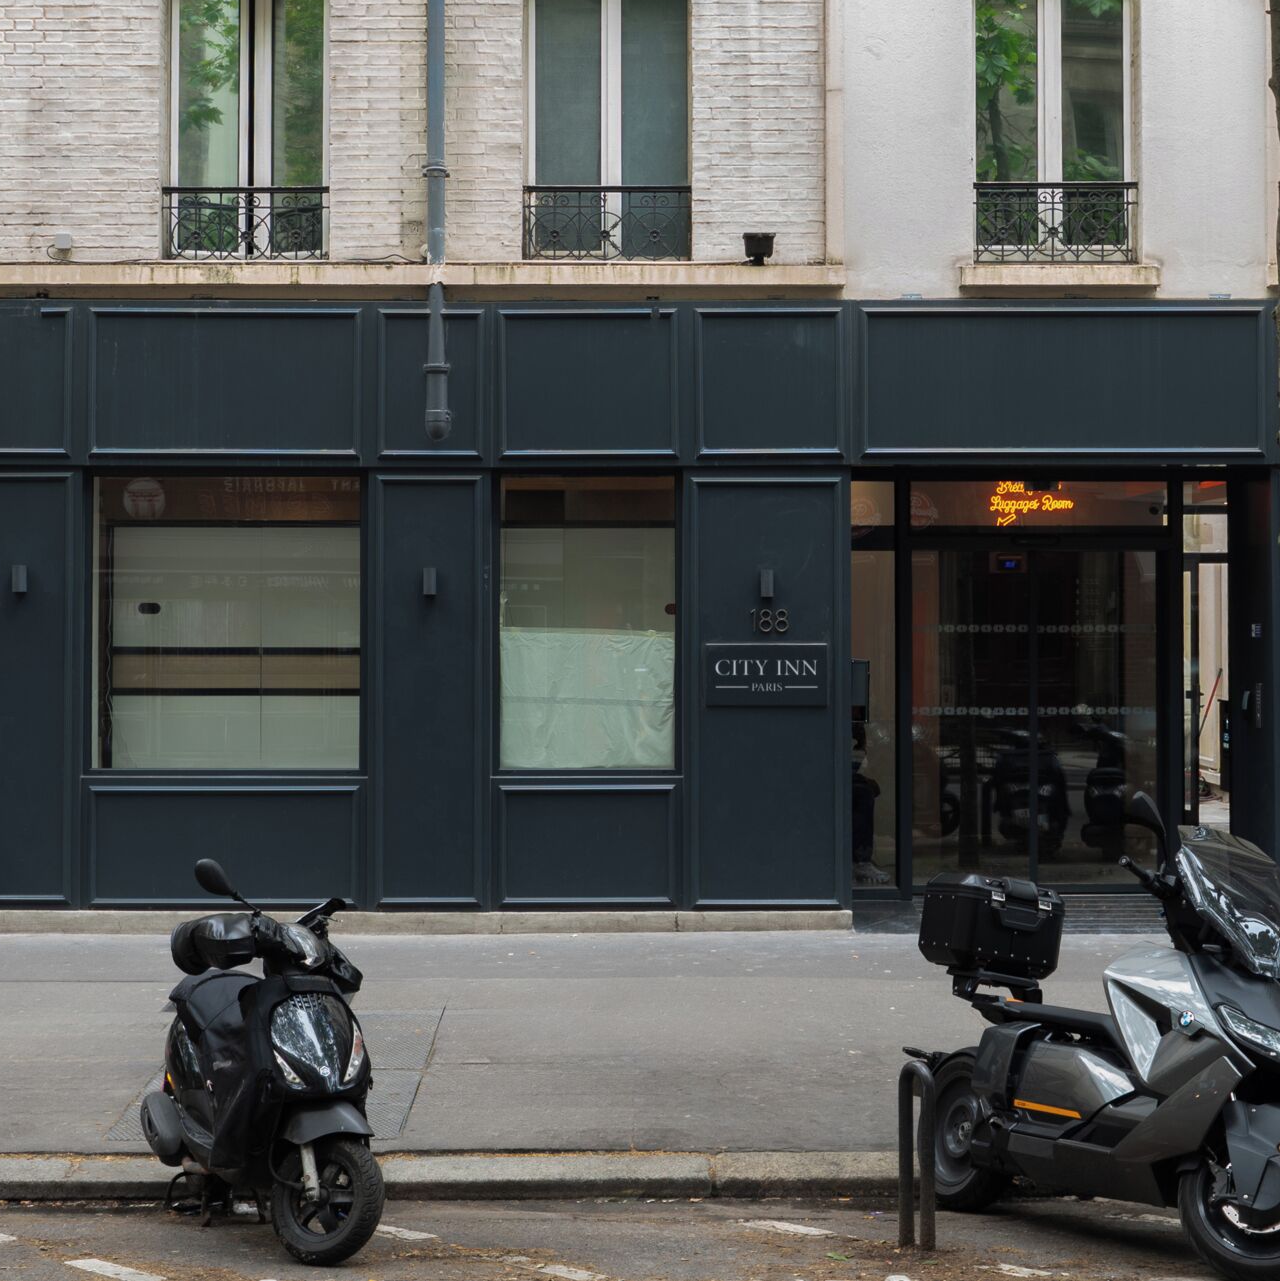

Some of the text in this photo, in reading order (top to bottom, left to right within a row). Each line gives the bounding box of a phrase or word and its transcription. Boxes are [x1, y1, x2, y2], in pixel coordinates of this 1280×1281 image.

[989, 494, 1074, 513] Luggages Room
[749, 608, 790, 632] 188
[715, 659, 818, 676] CITY INN
[751, 683, 783, 692] PARIS
